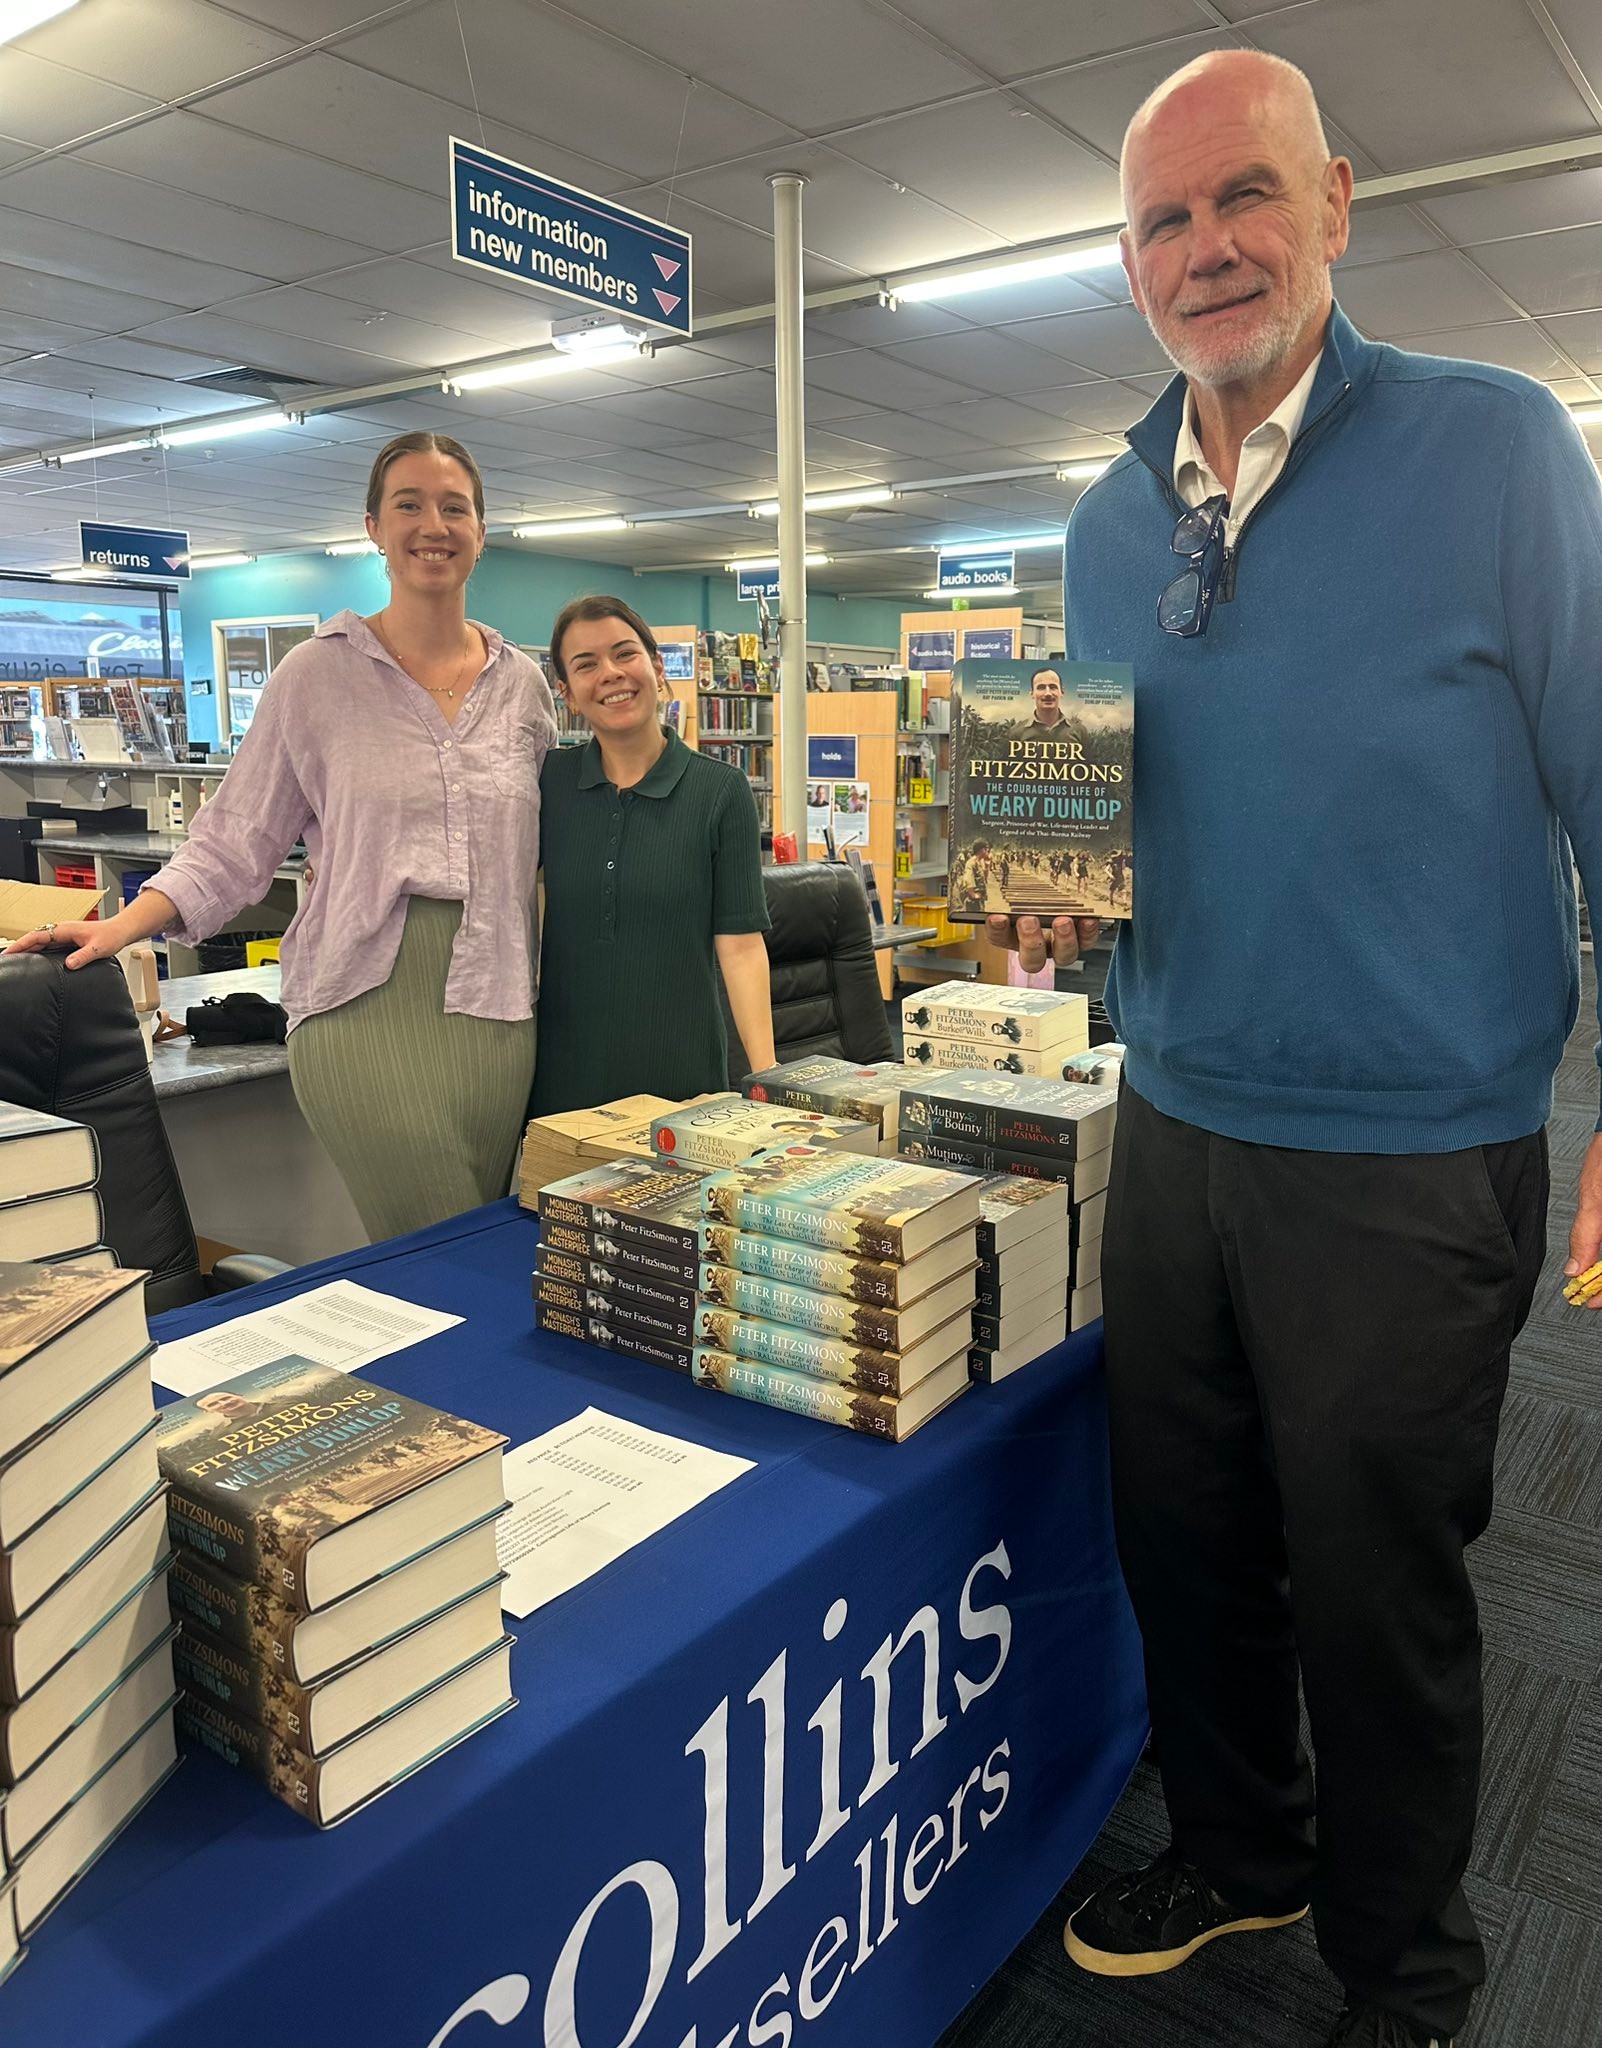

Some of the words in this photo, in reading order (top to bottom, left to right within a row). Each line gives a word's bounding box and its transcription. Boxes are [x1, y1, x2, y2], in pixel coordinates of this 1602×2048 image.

[469, 181, 608, 260] information
[470, 226, 523, 265] new
[531, 247, 639, 305] members
[90, 549, 151, 568] returns
[941, 572, 971, 586] audio
[974, 570, 1008, 583] books
[741, 583, 764, 597] large
[766, 583, 781, 596] pri
[917, 649, 933, 657] audio
[934, 649, 953, 657] books
[970, 650, 991, 658] fiction
[971, 642, 1001, 651] historical
[821, 752, 842, 761] holds
[1008, 740, 1086, 761] PETER
[969, 759, 1123, 783] FITZSIMONS
[911, 783, 933, 799] EF
[986, 782, 1003, 793] THE
[1007, 783, 1068, 796] COURAGEOUS
[1070, 785, 1091, 797] LIFE
[1095, 787, 1106, 797] OF
[969, 794, 1037, 817] WEARY
[1043, 797, 1122, 821] DUNLOP
[936, 1014, 987, 1028] FITZSIMONS
[947, 1008, 974, 1018] PETER
[938, 1050, 989, 1063] FITZSIMONS
[950, 1043, 976, 1054] PETER
[774, 1096, 824, 1113] FITZSIMONS
[785, 1090, 812, 1103] PETER
[690, 1103, 760, 1127] COOK
[928, 1104, 965, 1122] Mutiny
[945, 1117, 982, 1136] Bounty
[1000, 1128, 1056, 1144] FITZSIMONS
[1013, 1121, 1041, 1133] PETER
[684, 1140, 736, 1160] FITZSIMONS
[697, 1134, 723, 1147] PETER
[688, 1151, 710, 1161] JAMES
[710, 1157, 732, 1167] COOK
[927, 1145, 964, 1163] Mutiny
[789, 1160, 829, 1183] PETER
[1011, 1163, 1040, 1175] PETER
[544, 1207, 588, 1227] MASTERPIECE
[549, 1198, 584, 1216] MONASH'S
[737, 1198, 772, 1217] PETER
[775, 1207, 849, 1234] FITZSIMONS
[551, 1225, 586, 1243] MONASH'S
[620, 1221, 638, 1233] Peter
[639, 1226, 678, 1244] FitzSimons
[743, 1221, 790, 1238] AUSTRALIAN
[790, 1231, 815, 1241] LIGHT
[807, 1226, 817, 1235] of
[547, 1235, 590, 1256] MASTERPIECE
[547, 1254, 581, 1272] MONASH'S
[622, 1250, 640, 1263] Peter
[641, 1255, 680, 1273] FitzSimons
[733, 1238, 768, 1257] PETER
[771, 1247, 844, 1276] FITZSIMONS
[543, 1263, 586, 1284] MASTERPIECE
[740, 1261, 786, 1278] AUSTRALIAN
[786, 1271, 811, 1283] LIGHT
[803, 1267, 813, 1276] of
[543, 1281, 577, 1299] MONASH'S
[618, 1279, 635, 1292] Peter
[636, 1284, 675, 1303] FitzSimons
[735, 1279, 770, 1298] PETER
[773, 1291, 845, 1320] FITZSIMONS
[538, 1291, 582, 1311] MASTERPIECE
[546, 1309, 581, 1327] MONASH'S
[615, 1306, 632, 1319] Peter
[633, 1311, 673, 1331] FitzSimons
[741, 1302, 788, 1320] AUSTRALIAN
[788, 1313, 812, 1326] LIGHT
[804, 1311, 814, 1320] of
[542, 1318, 585, 1340] MASTERPIECE
[617, 1336, 634, 1348] Peter
[635, 1341, 674, 1361] FitzSimons
[732, 1325, 767, 1344] PETER
[771, 1334, 845, 1364] FITZSIMONS
[739, 1347, 786, 1366] AUSTRALIAN
[787, 1359, 812, 1372] LIGHT
[804, 1357, 814, 1366] of
[814, 1359, 823, 1367] the
[729, 1367, 765, 1386] PETER
[768, 1377, 843, 1409] FITZSIMONS
[736, 1389, 784, 1409] AUSTRALIAN
[784, 1402, 809, 1415] LIGHT
[801, 1399, 811, 1409] of
[811, 1402, 821, 1410] the
[186, 1389, 378, 1479] FITZSIMONS
[219, 1401, 321, 1448] PETER
[214, 1445, 312, 1492] WEARY
[312, 1401, 403, 1451] DUNLOP
[228, 1457, 252, 1473] THE
[253, 1424, 329, 1463] COURAGEOUS
[329, 1413, 355, 1432] LIFE
[355, 1406, 371, 1418] OF
[170, 1493, 245, 1546] FITZSIMONS
[188, 1530, 227, 1562] DUNLOP
[171, 1561, 237, 1616] FITZSIMONS
[178, 1632, 250, 1687] FITZSIMONS
[673, 1738, 1012, 2048] sellers
